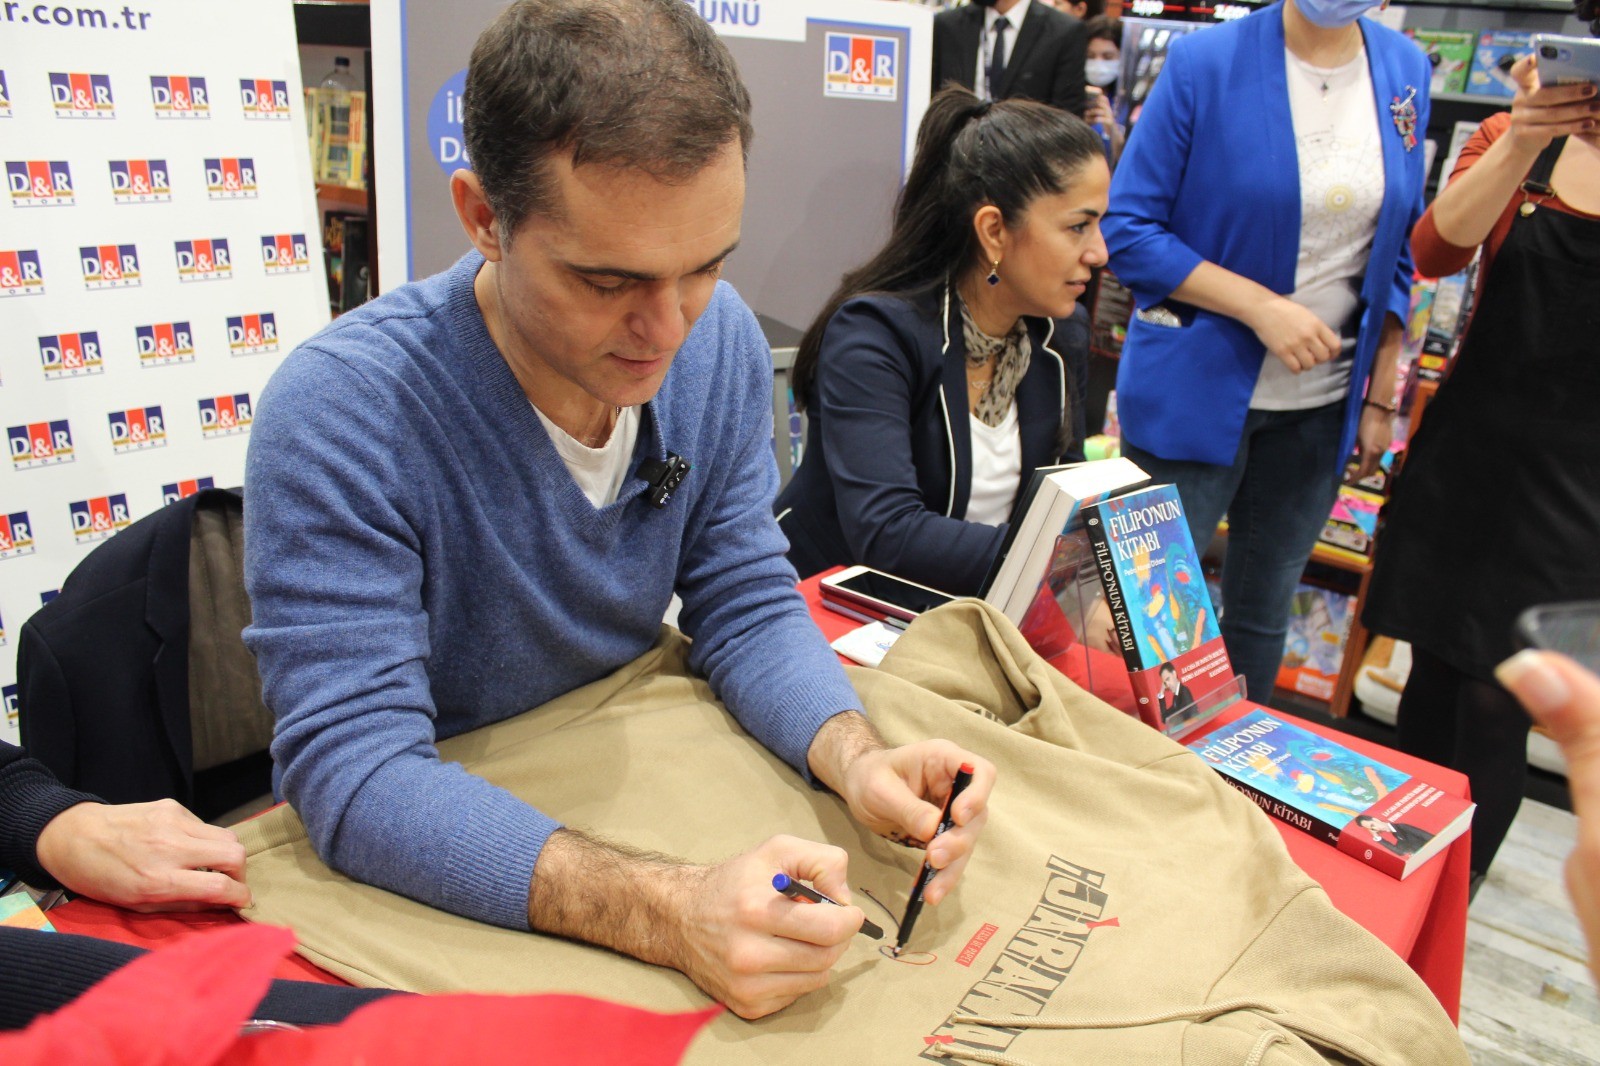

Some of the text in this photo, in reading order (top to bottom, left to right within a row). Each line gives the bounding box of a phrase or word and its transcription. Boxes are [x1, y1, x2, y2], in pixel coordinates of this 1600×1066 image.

[0, 1, 152, 30] r.com.tr
[829, 50, 894, 83] D&R
[51, 84, 112, 109] D&R
[152, 85, 208, 110] D&R
[242, 88, 288, 111] D&R
[9, 172, 72, 197] D&R
[111, 171, 169, 194] D&R
[206, 168, 256, 190] D&R
[82, 253, 139, 280] D&R
[177, 247, 231, 272] D&R
[263, 243, 308, 265] D&R
[0, 261, 39, 287] &R
[137, 334, 192, 357] D&R
[228, 322, 276, 346] D&R
[42, 342, 102, 368] D&R
[200, 402, 252, 428] D&R
[110, 416, 164, 442] D&R
[10, 430, 72, 458] D&R
[72, 503, 131, 532] D&R
[0, 522, 33, 550] &R
[1116, 531, 1160, 561] KİTABI
[1115, 610, 1135, 651] KİTABI
[1224, 741, 1276, 772] KİTABI
[1273, 805, 1312, 830] KİTABI
